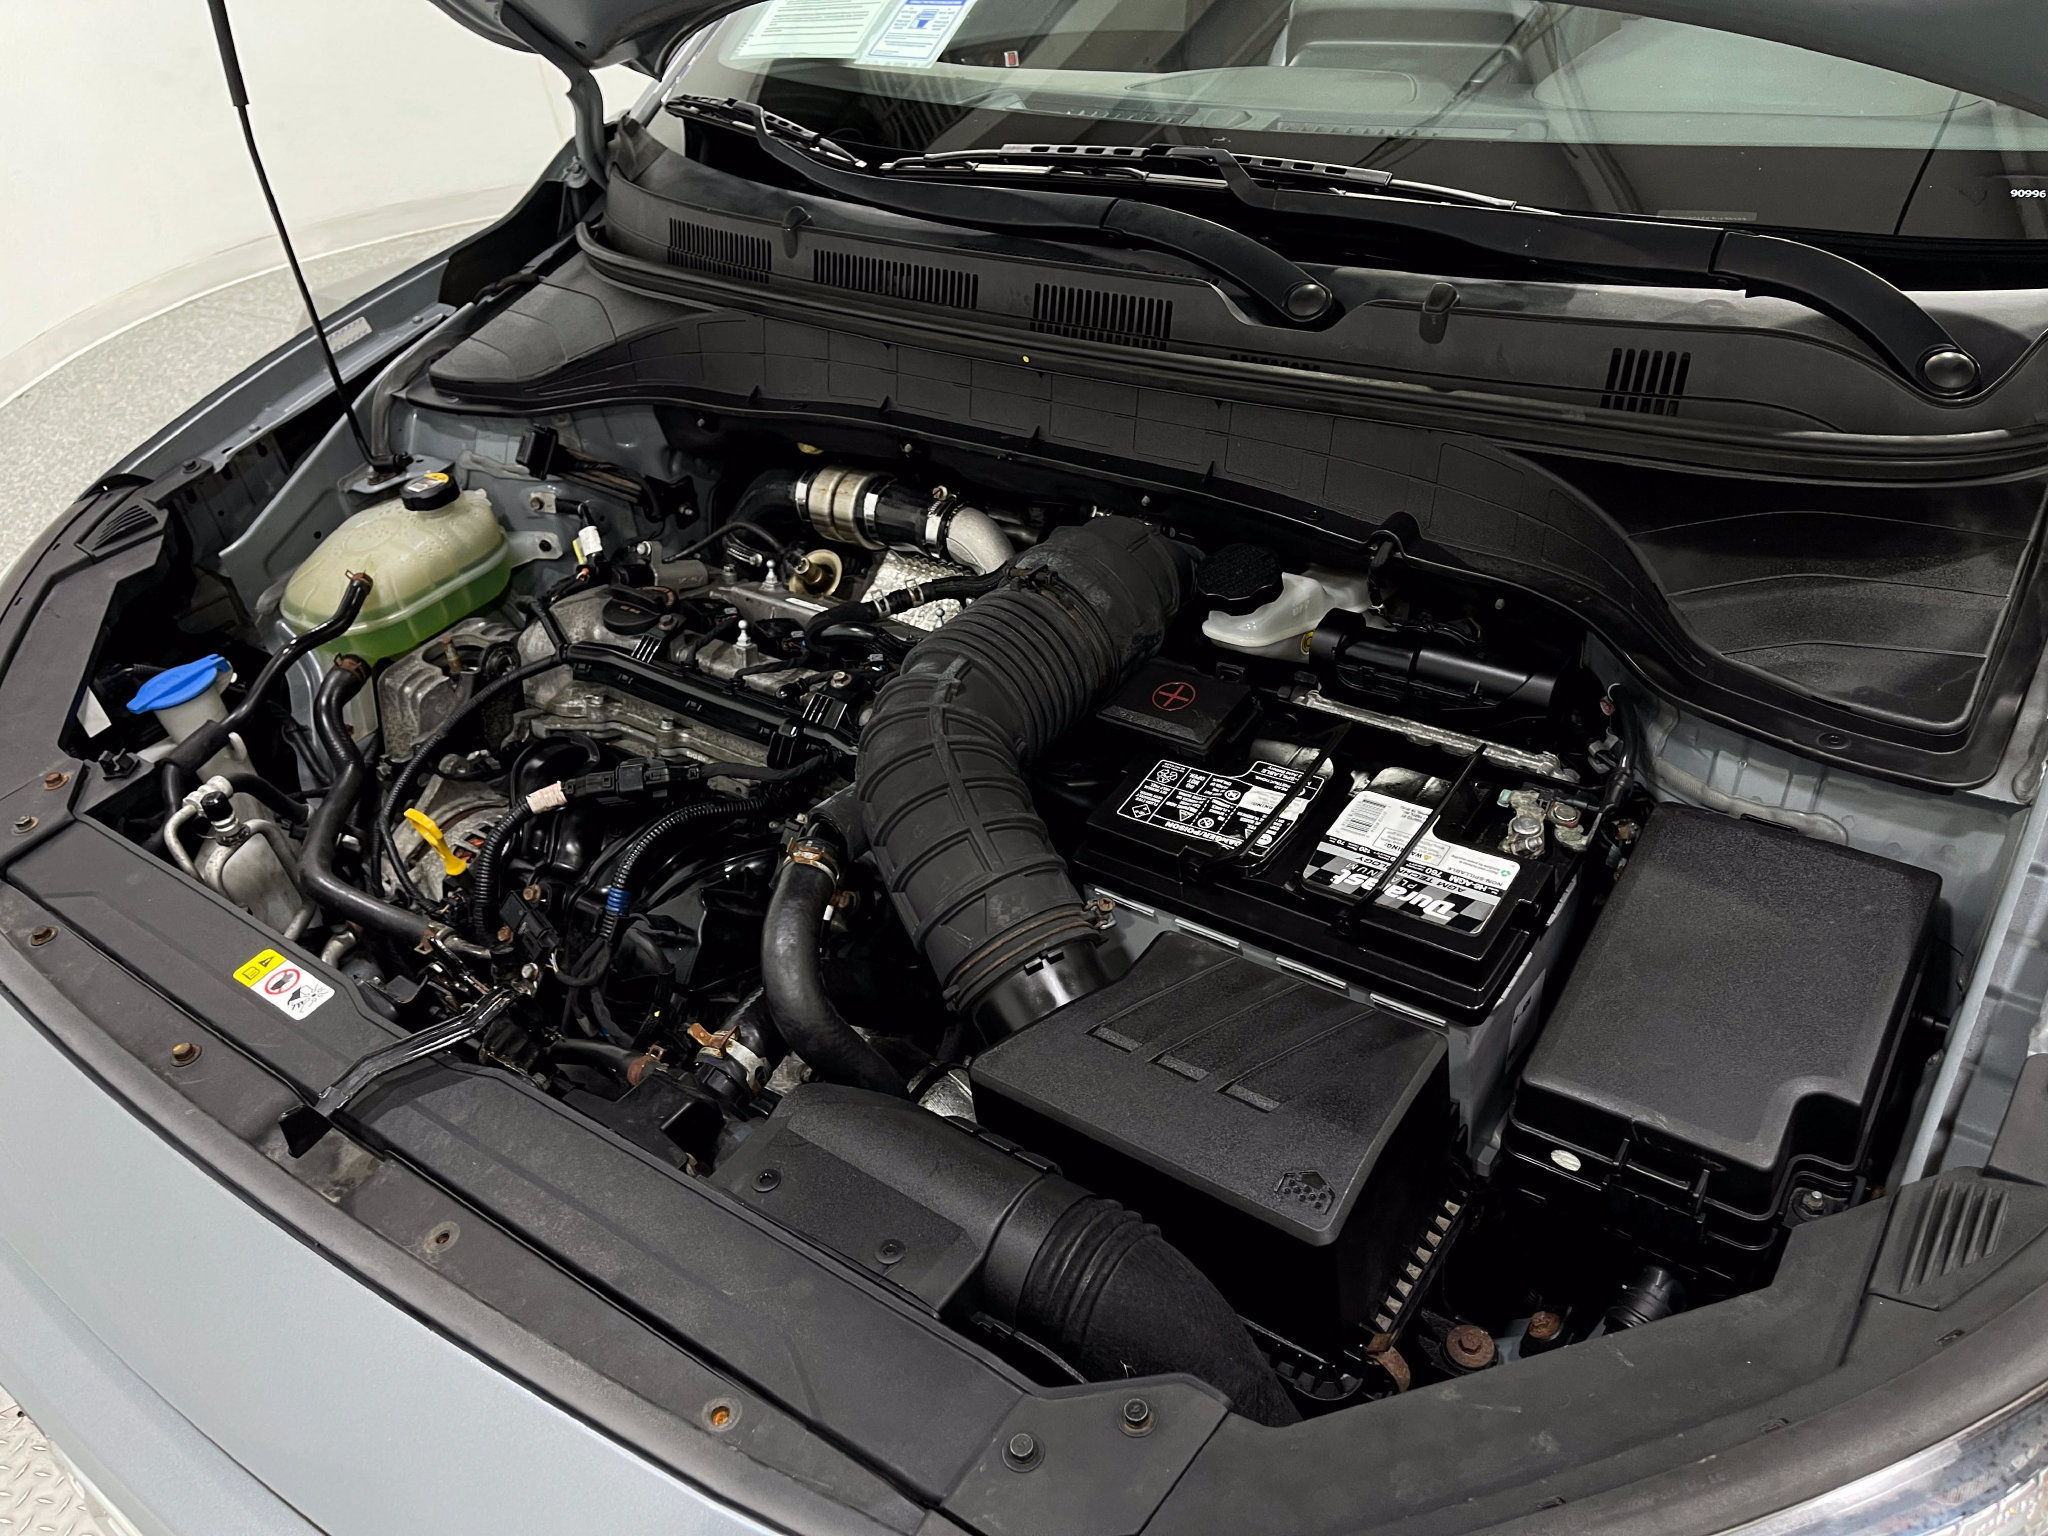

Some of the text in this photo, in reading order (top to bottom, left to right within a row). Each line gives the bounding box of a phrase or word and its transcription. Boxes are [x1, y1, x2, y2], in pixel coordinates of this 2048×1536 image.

[2009, 188, 2047, 198] 90996
[1344, 860, 1417, 889] PLAINUM
[1355, 856, 1433, 883] TECHNLOGY
[1424, 867, 1443, 878] 760
[1330, 868, 1455, 920] Duraast
[1436, 881, 1466, 892] AGM
